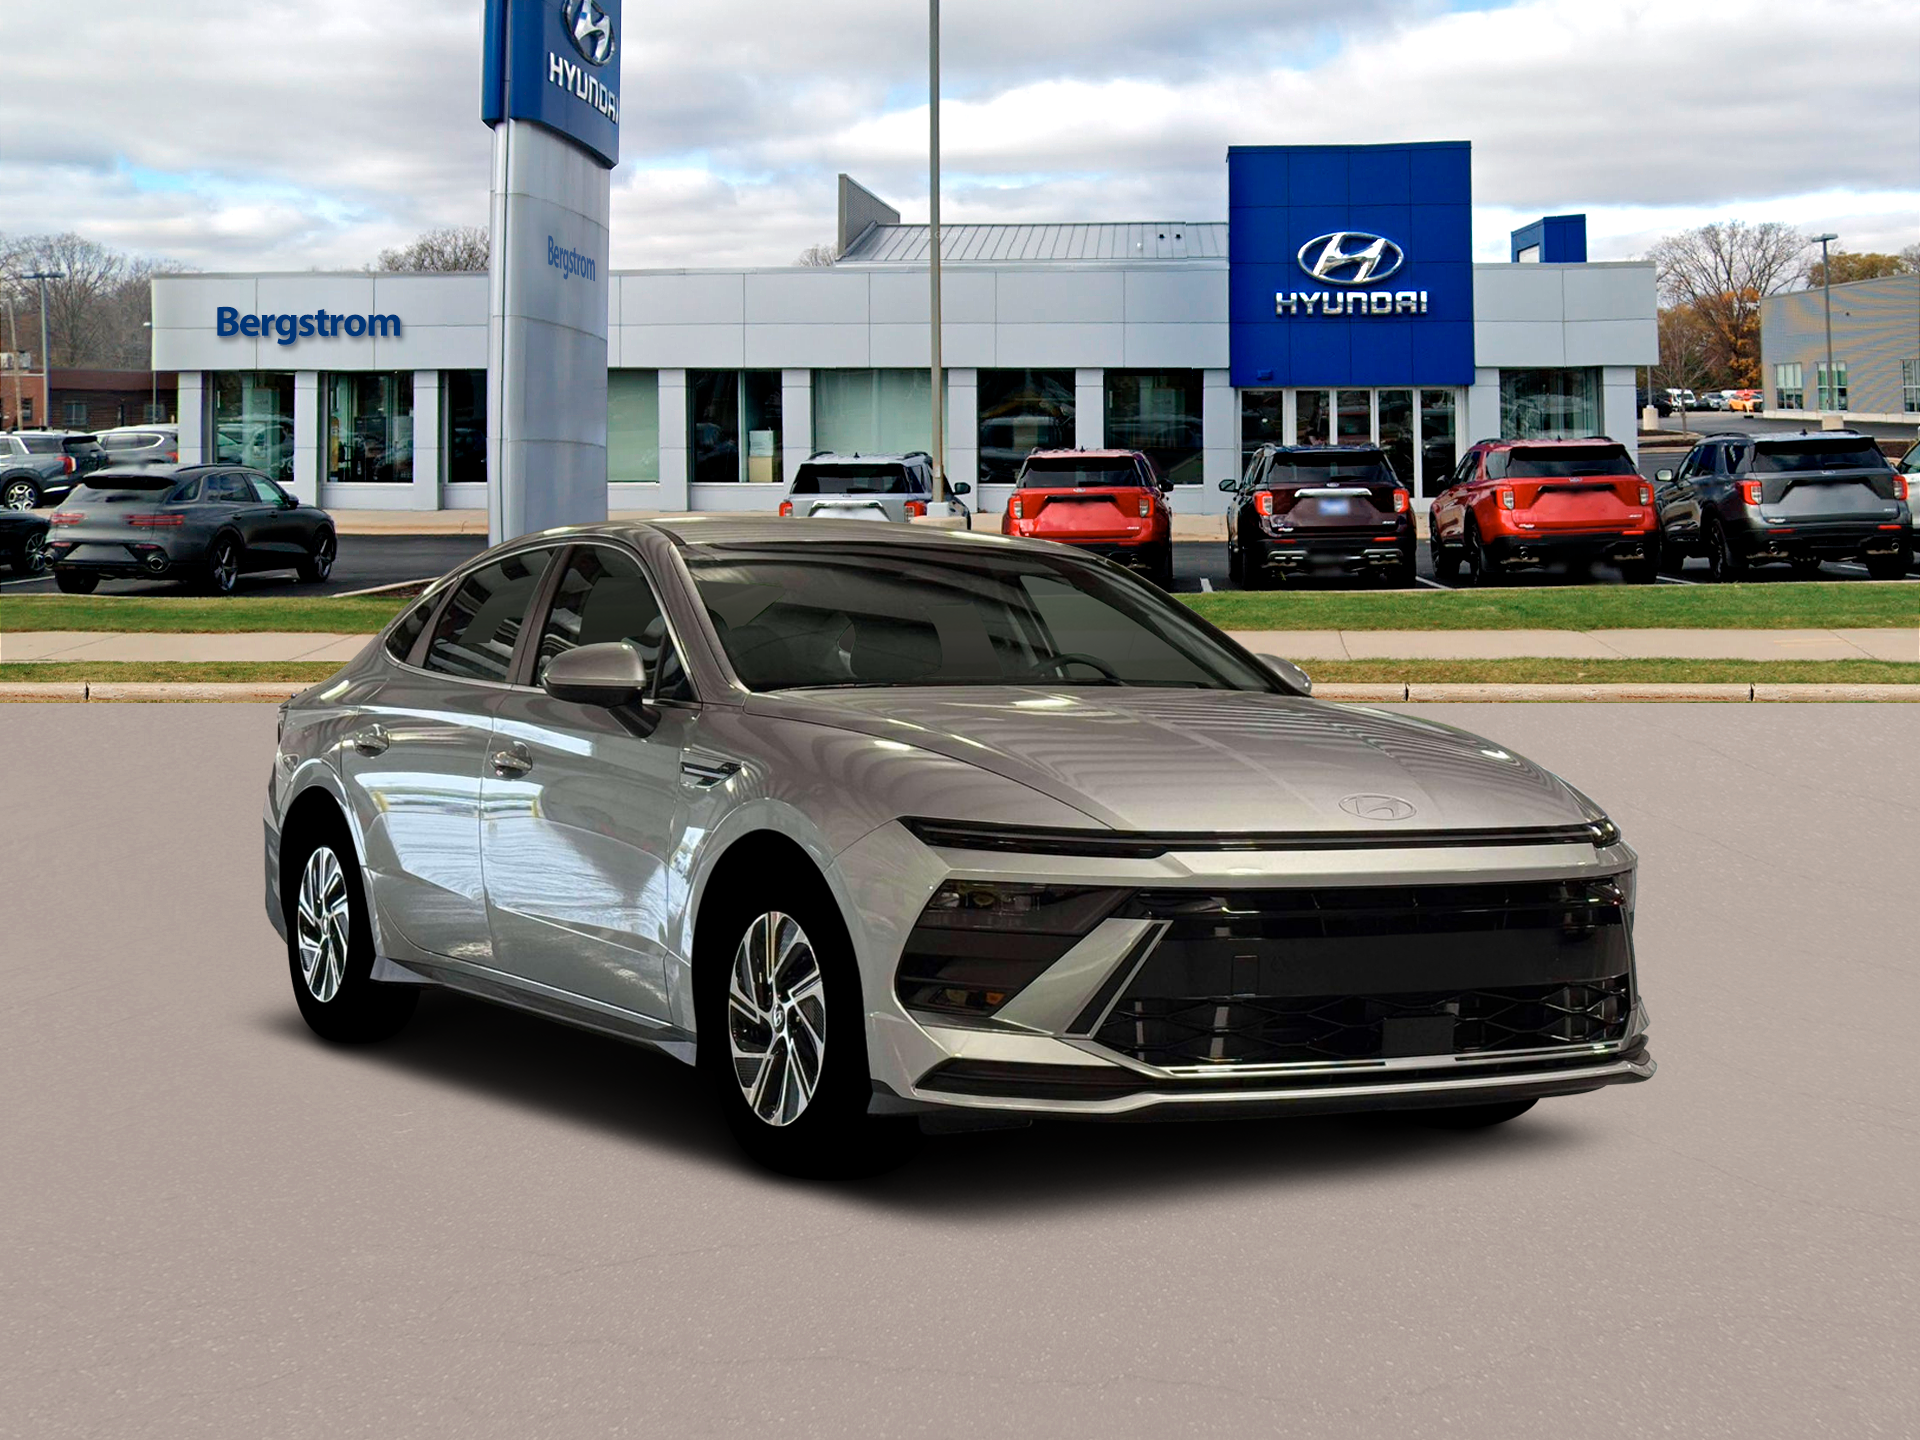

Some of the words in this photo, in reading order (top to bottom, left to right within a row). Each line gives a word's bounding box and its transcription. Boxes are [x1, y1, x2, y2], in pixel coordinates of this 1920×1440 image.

[549, 51, 619, 124] HYUNDAI
[548, 235, 596, 282] Bergstrom
[1275, 290, 1428, 316] HYUNDAI
[216, 306, 402, 346] Bergstrom
